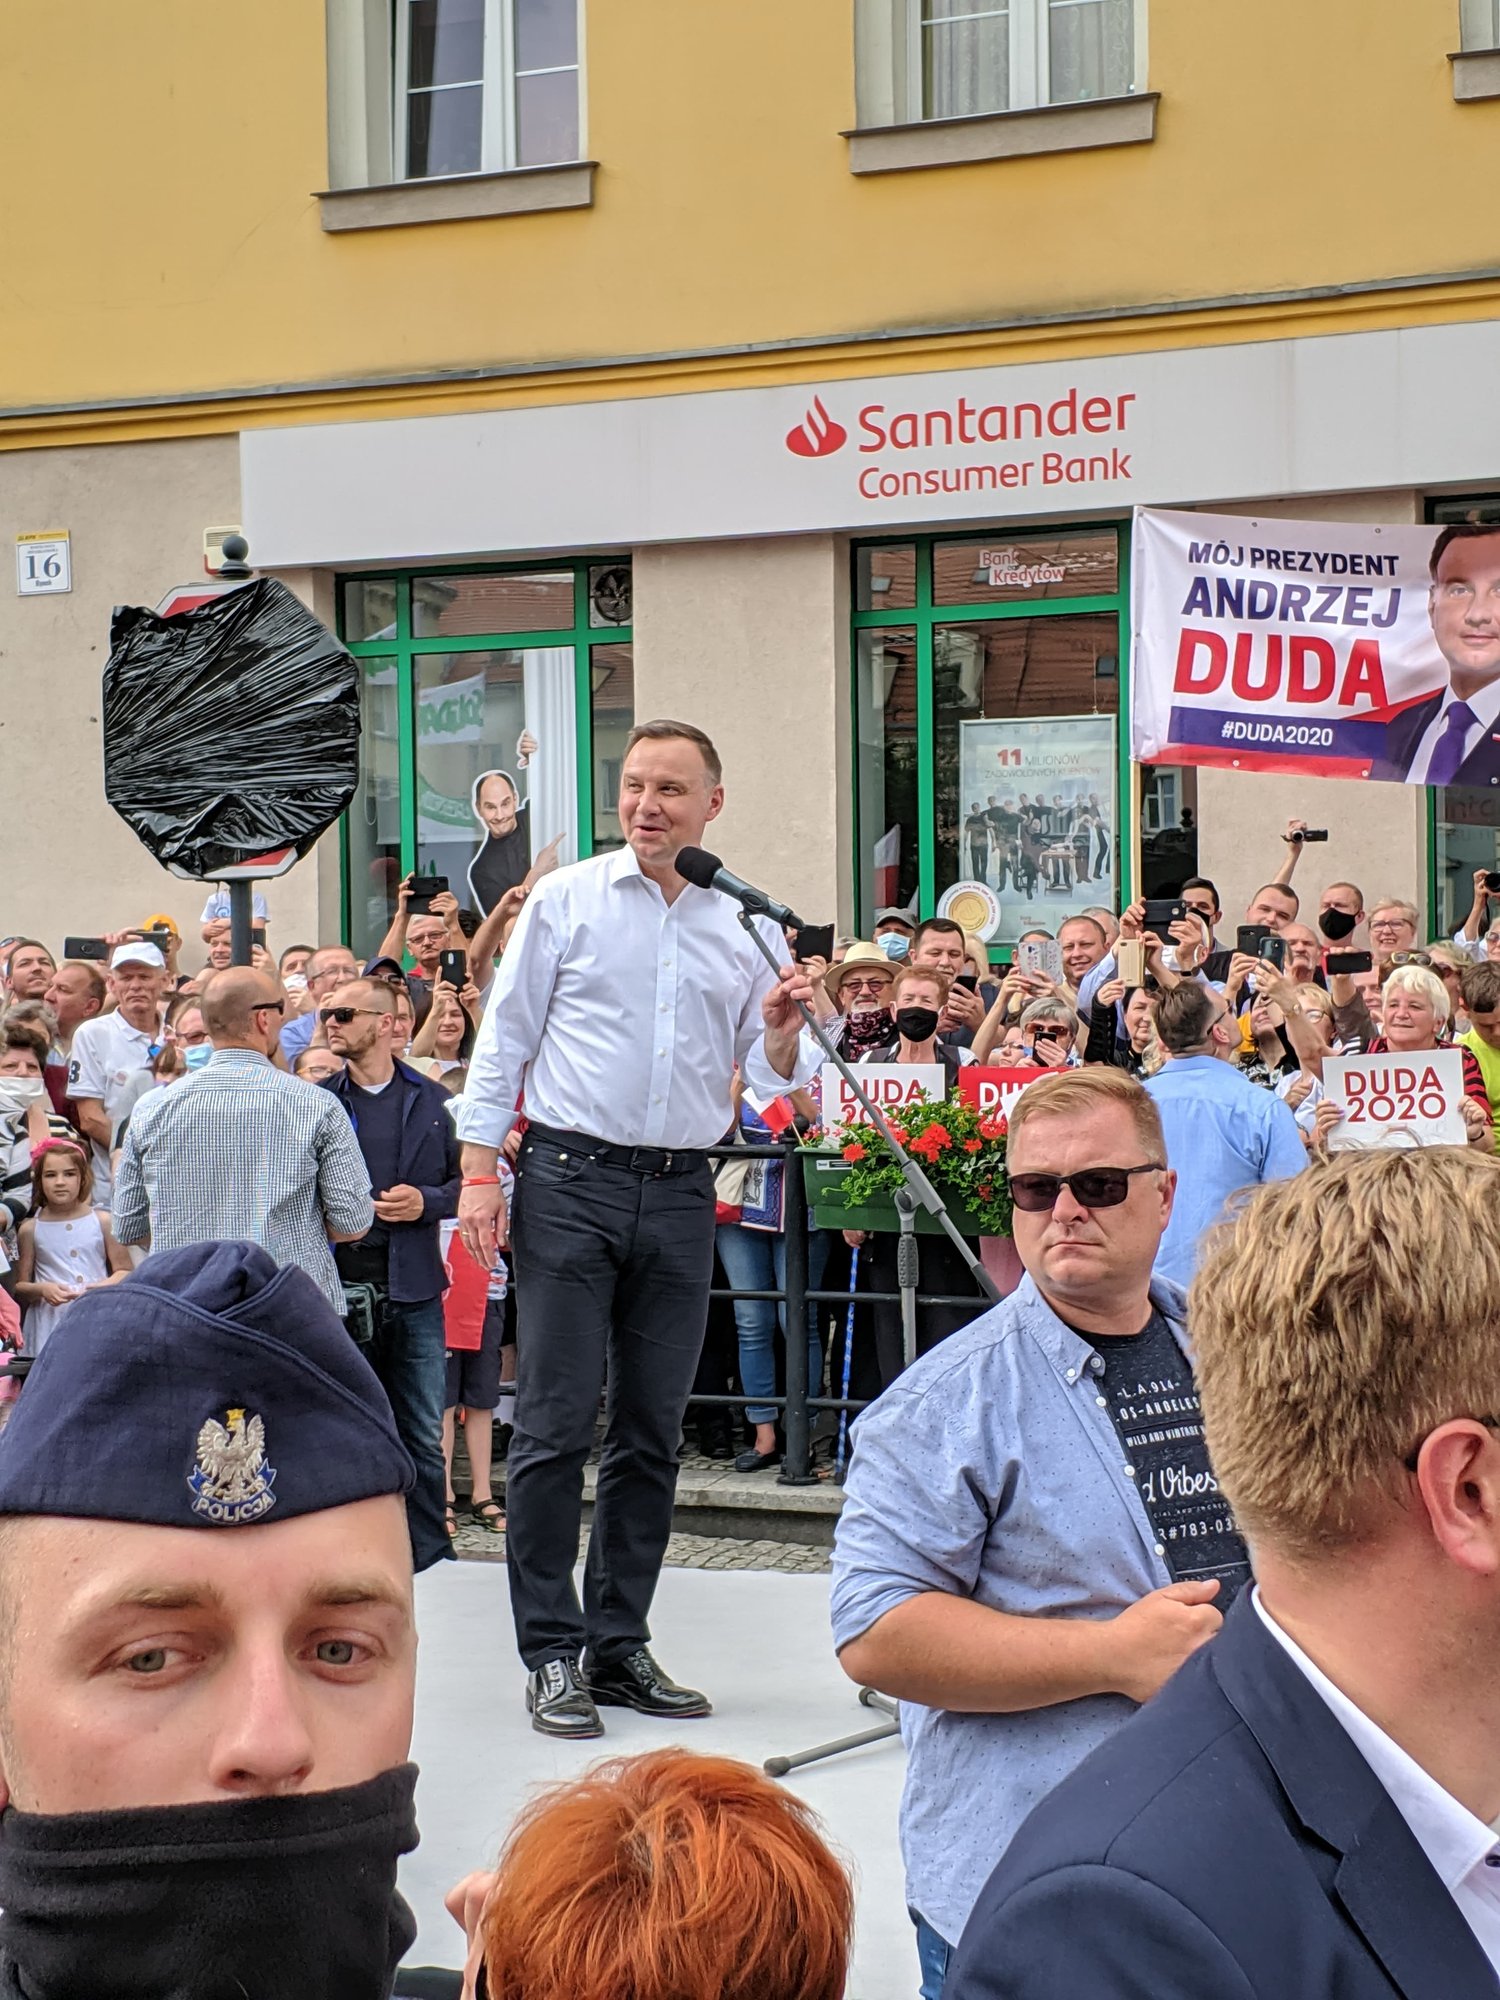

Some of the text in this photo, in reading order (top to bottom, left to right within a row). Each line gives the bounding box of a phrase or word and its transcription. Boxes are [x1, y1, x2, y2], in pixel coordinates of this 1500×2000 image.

[858, 388, 1136, 453] Santander
[858, 448, 1132, 499] Consumer Bank
[26, 553, 61, 580] 16
[982, 550, 1019, 566] Bank
[1188, 540, 1399, 576] MÓJ PREZYDENT
[1181, 576, 1402, 628] ANDRZEJ
[1173, 628, 1389, 709] DUDA
[1221, 720, 1333, 746] #DUDA2020
[997, 748, 1022, 766] 11
[840, 1079, 924, 1104] DUDA
[1344, 1066, 1444, 1097] DUDA
[1347, 1092, 1446, 1123] 2020
[1116, 1396, 1200, 1422] OS-ANGELES
[1125, 1434, 1148, 1447] WILD
[1148, 1431, 1165, 1443] AND
[1165, 1425, 1200, 1440] VINTAGE
[1160, 1464, 1218, 1498] Vibes
[196, 1492, 273, 1522] POLICJA
